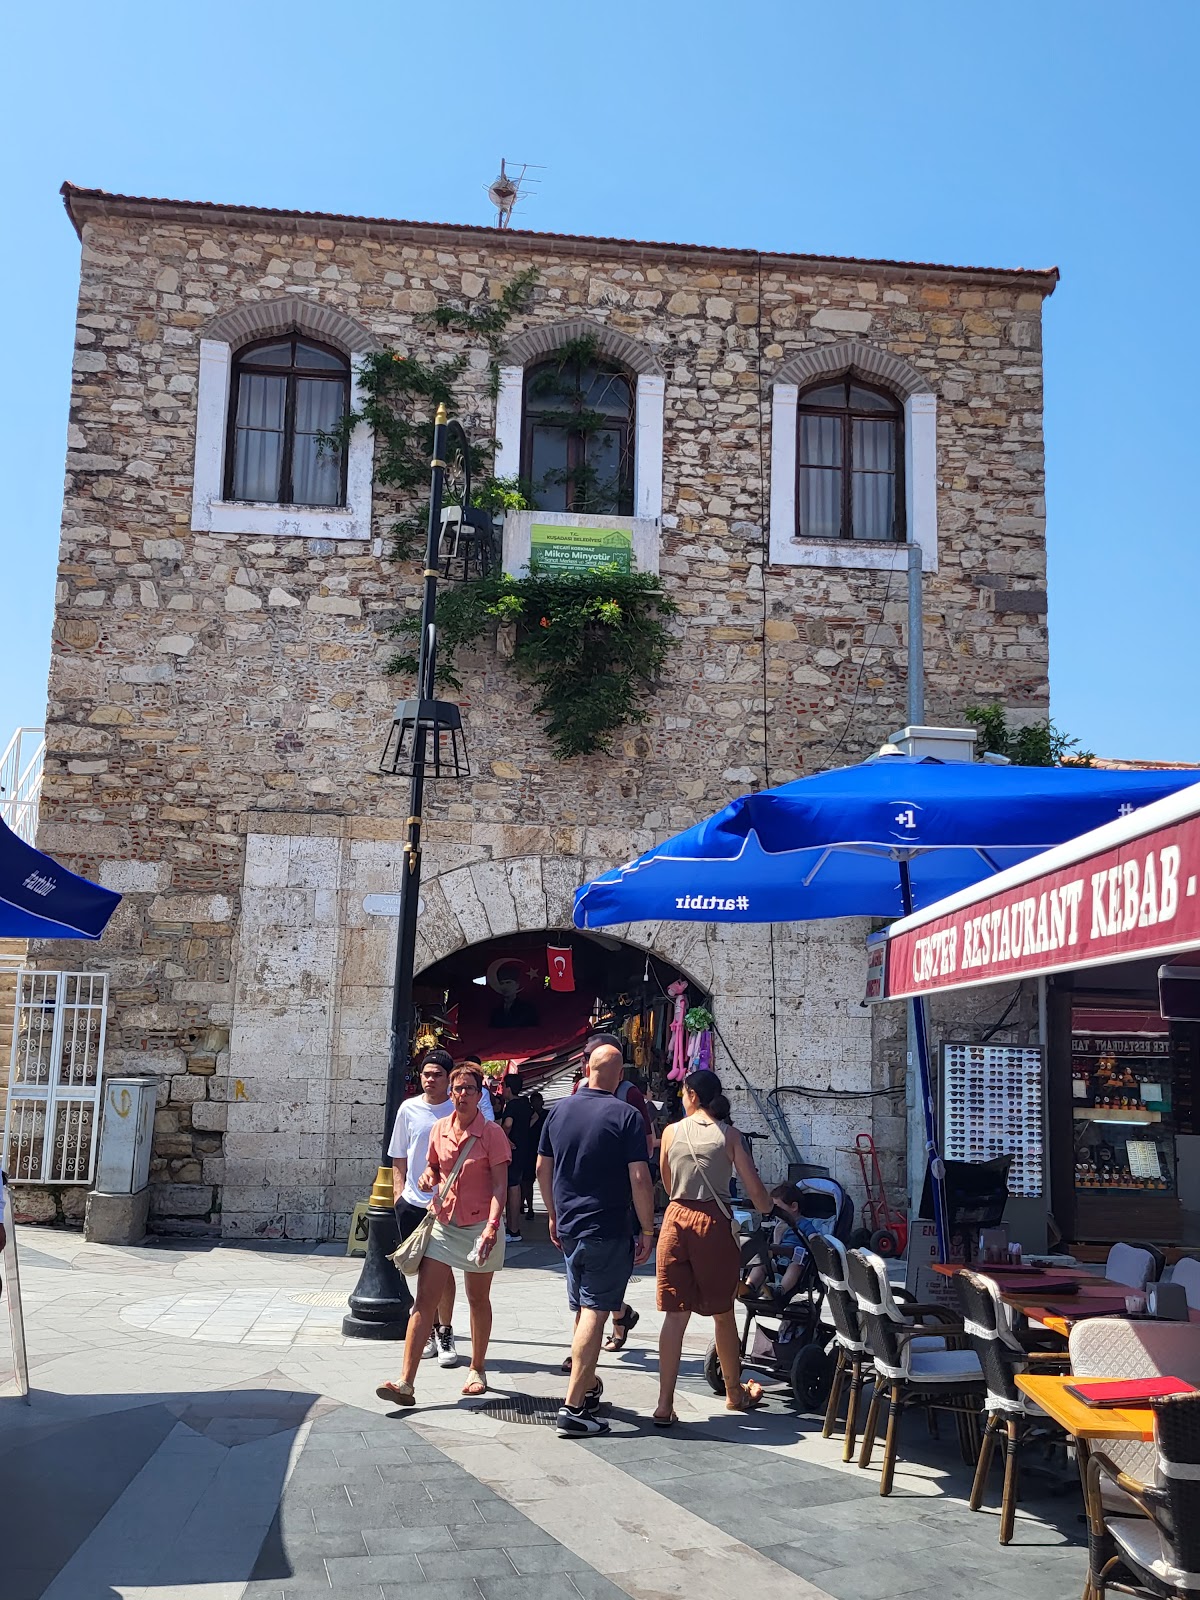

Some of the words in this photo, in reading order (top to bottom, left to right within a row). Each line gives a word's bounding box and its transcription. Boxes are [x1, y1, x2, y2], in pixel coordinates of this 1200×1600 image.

[545, 550, 570, 558] Mikro
[572, 552, 611, 561] Minyatür
[913, 925, 957, 982] CENTER
[962, 879, 1084, 969] RESTAURANT
[1090, 845, 1180, 939] KEBAB
